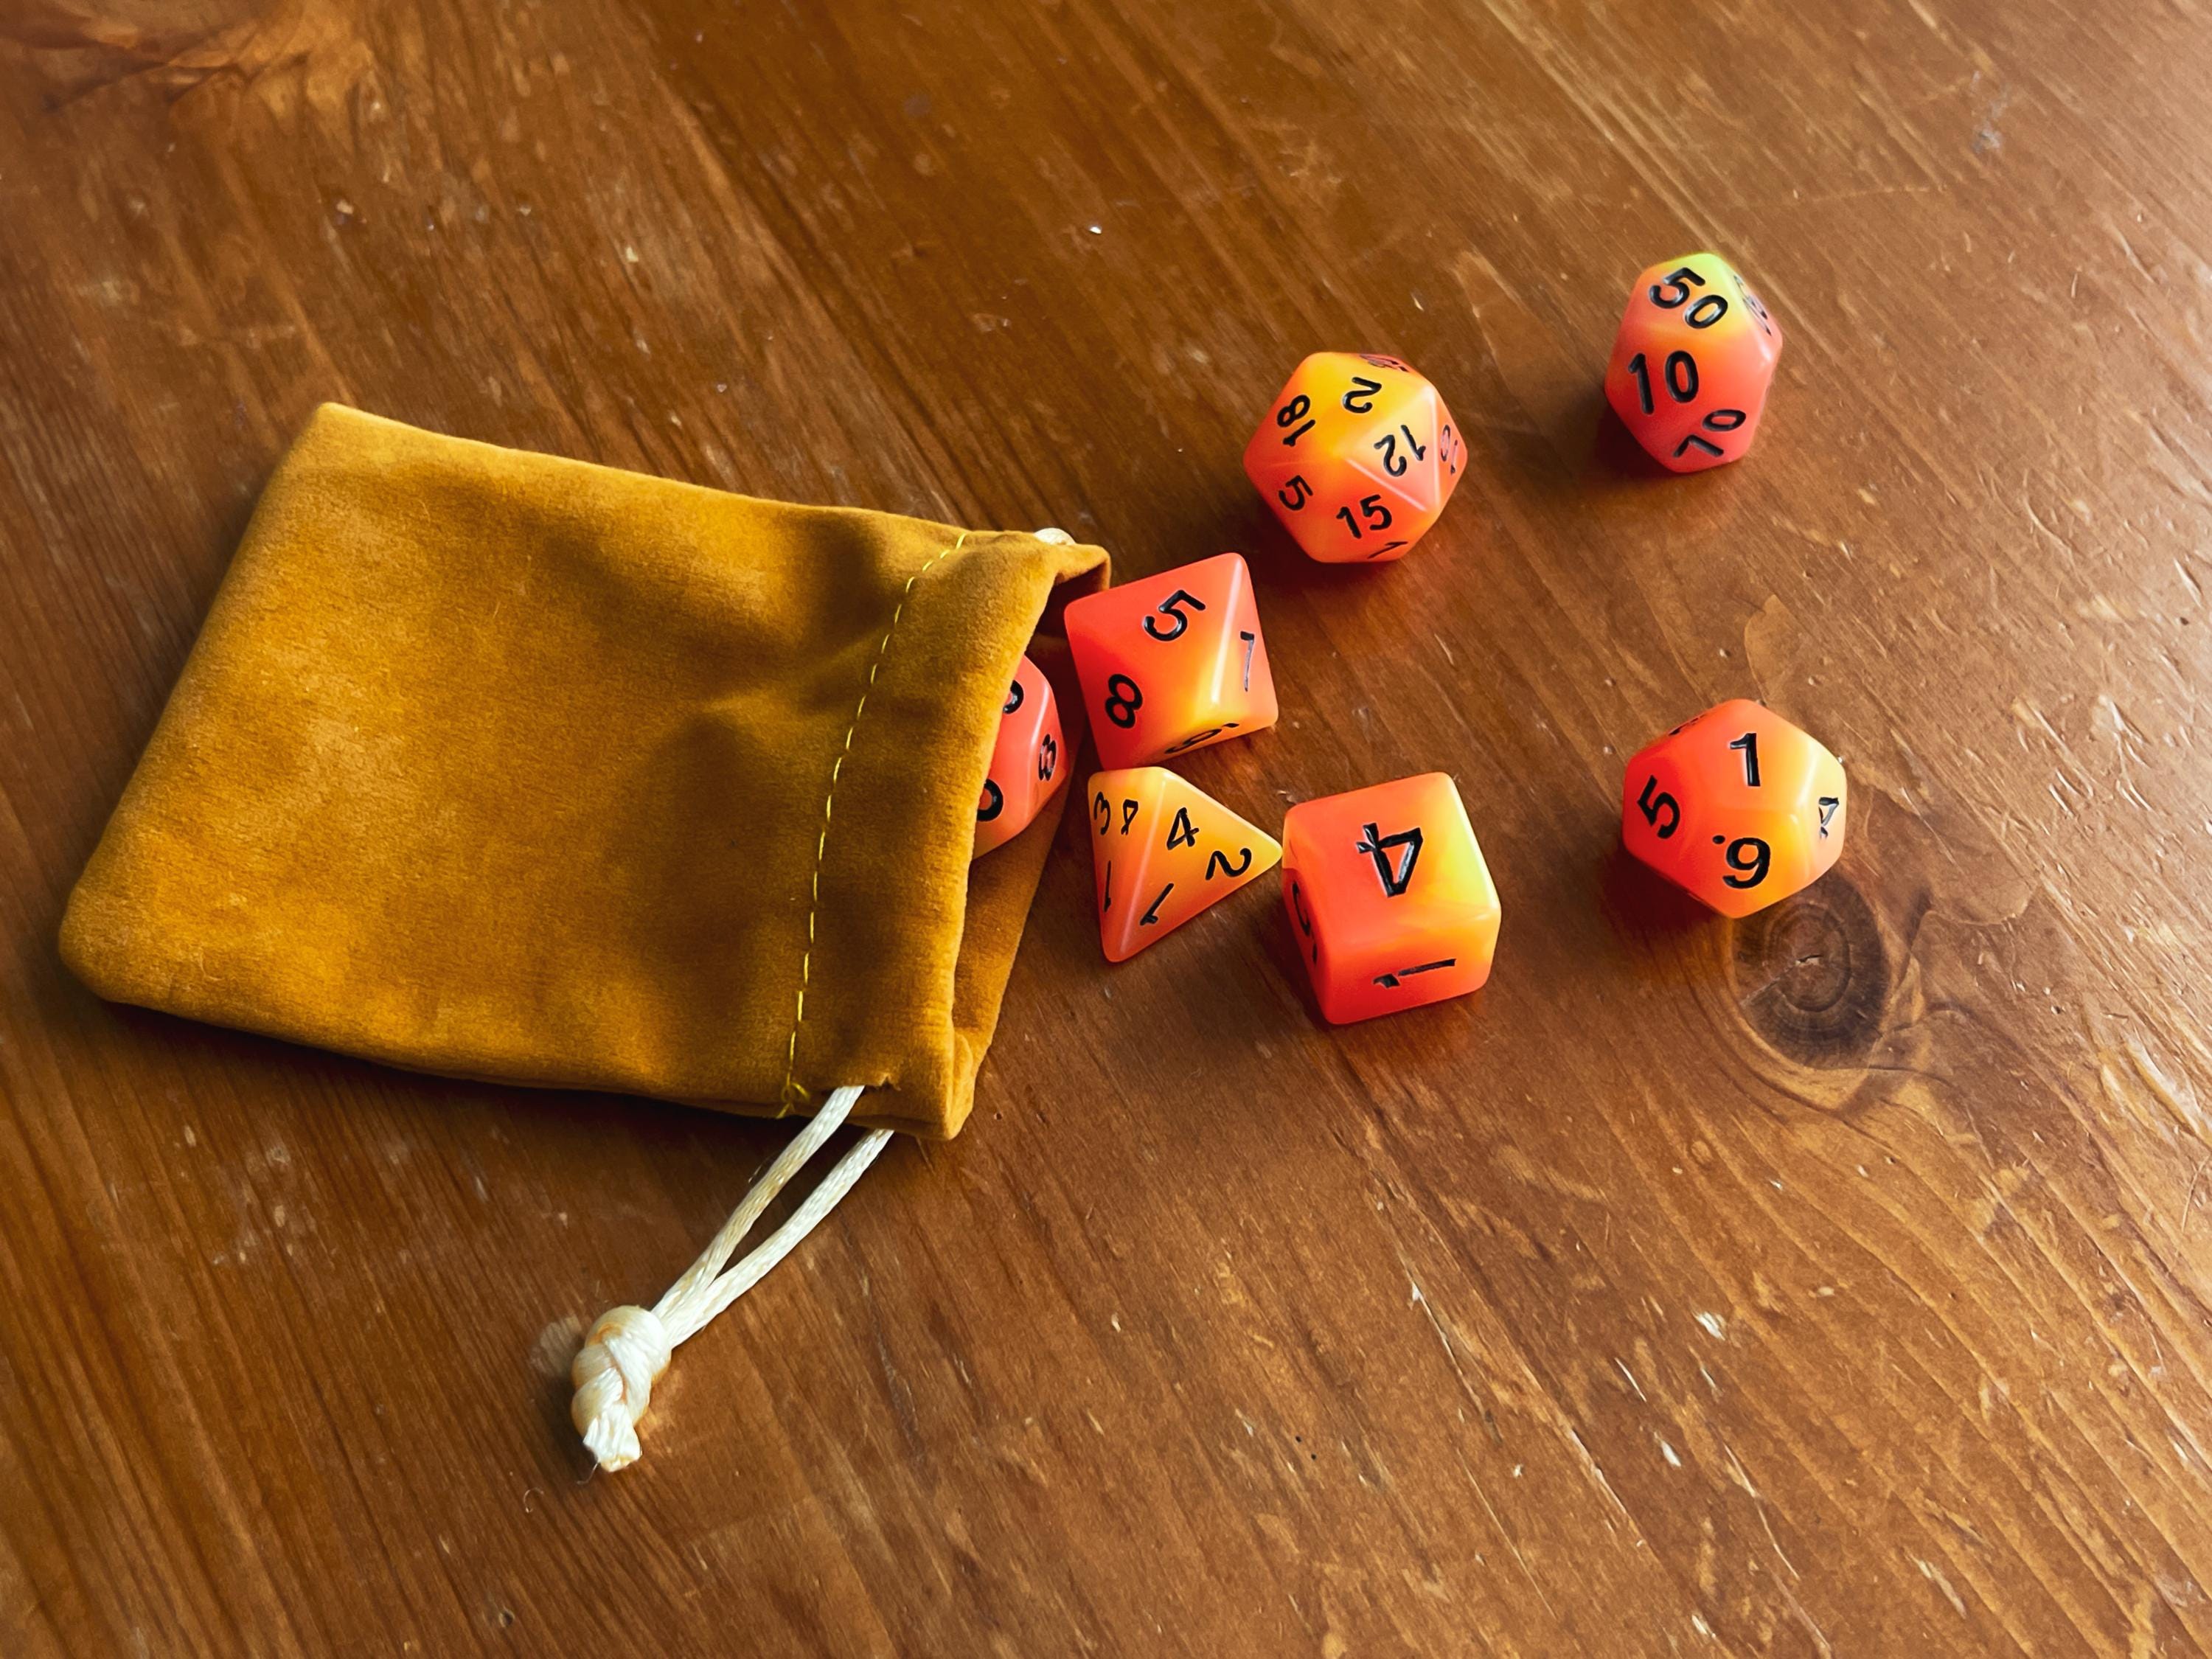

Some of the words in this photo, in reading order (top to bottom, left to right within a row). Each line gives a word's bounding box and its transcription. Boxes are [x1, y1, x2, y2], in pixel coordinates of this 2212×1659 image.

[1649, 267, 1728, 329] 50
[1342, 377, 1382, 414] 2
[1628, 350, 1699, 415] 10
[1277, 394, 1316, 447] 18
[1673, 409, 1746, 458] 70
[1374, 425, 1426, 477] 12
[1278, 475, 1313, 510] 5
[1336, 495, 1392, 539] 15
[1144, 590, 1206, 641] 5
[1106, 674, 1142, 728] 8
[1730, 733, 1761, 787] 1
[1093, 792, 1111, 835] 3
[1166, 807, 1199, 850] 4
[1637, 775, 1680, 839] 5
[1206, 848, 1252, 880] 2
[1357, 823, 1423, 897] 4
[1140, 883, 1174, 925] 1
[1372, 959, 1456, 989] 1
